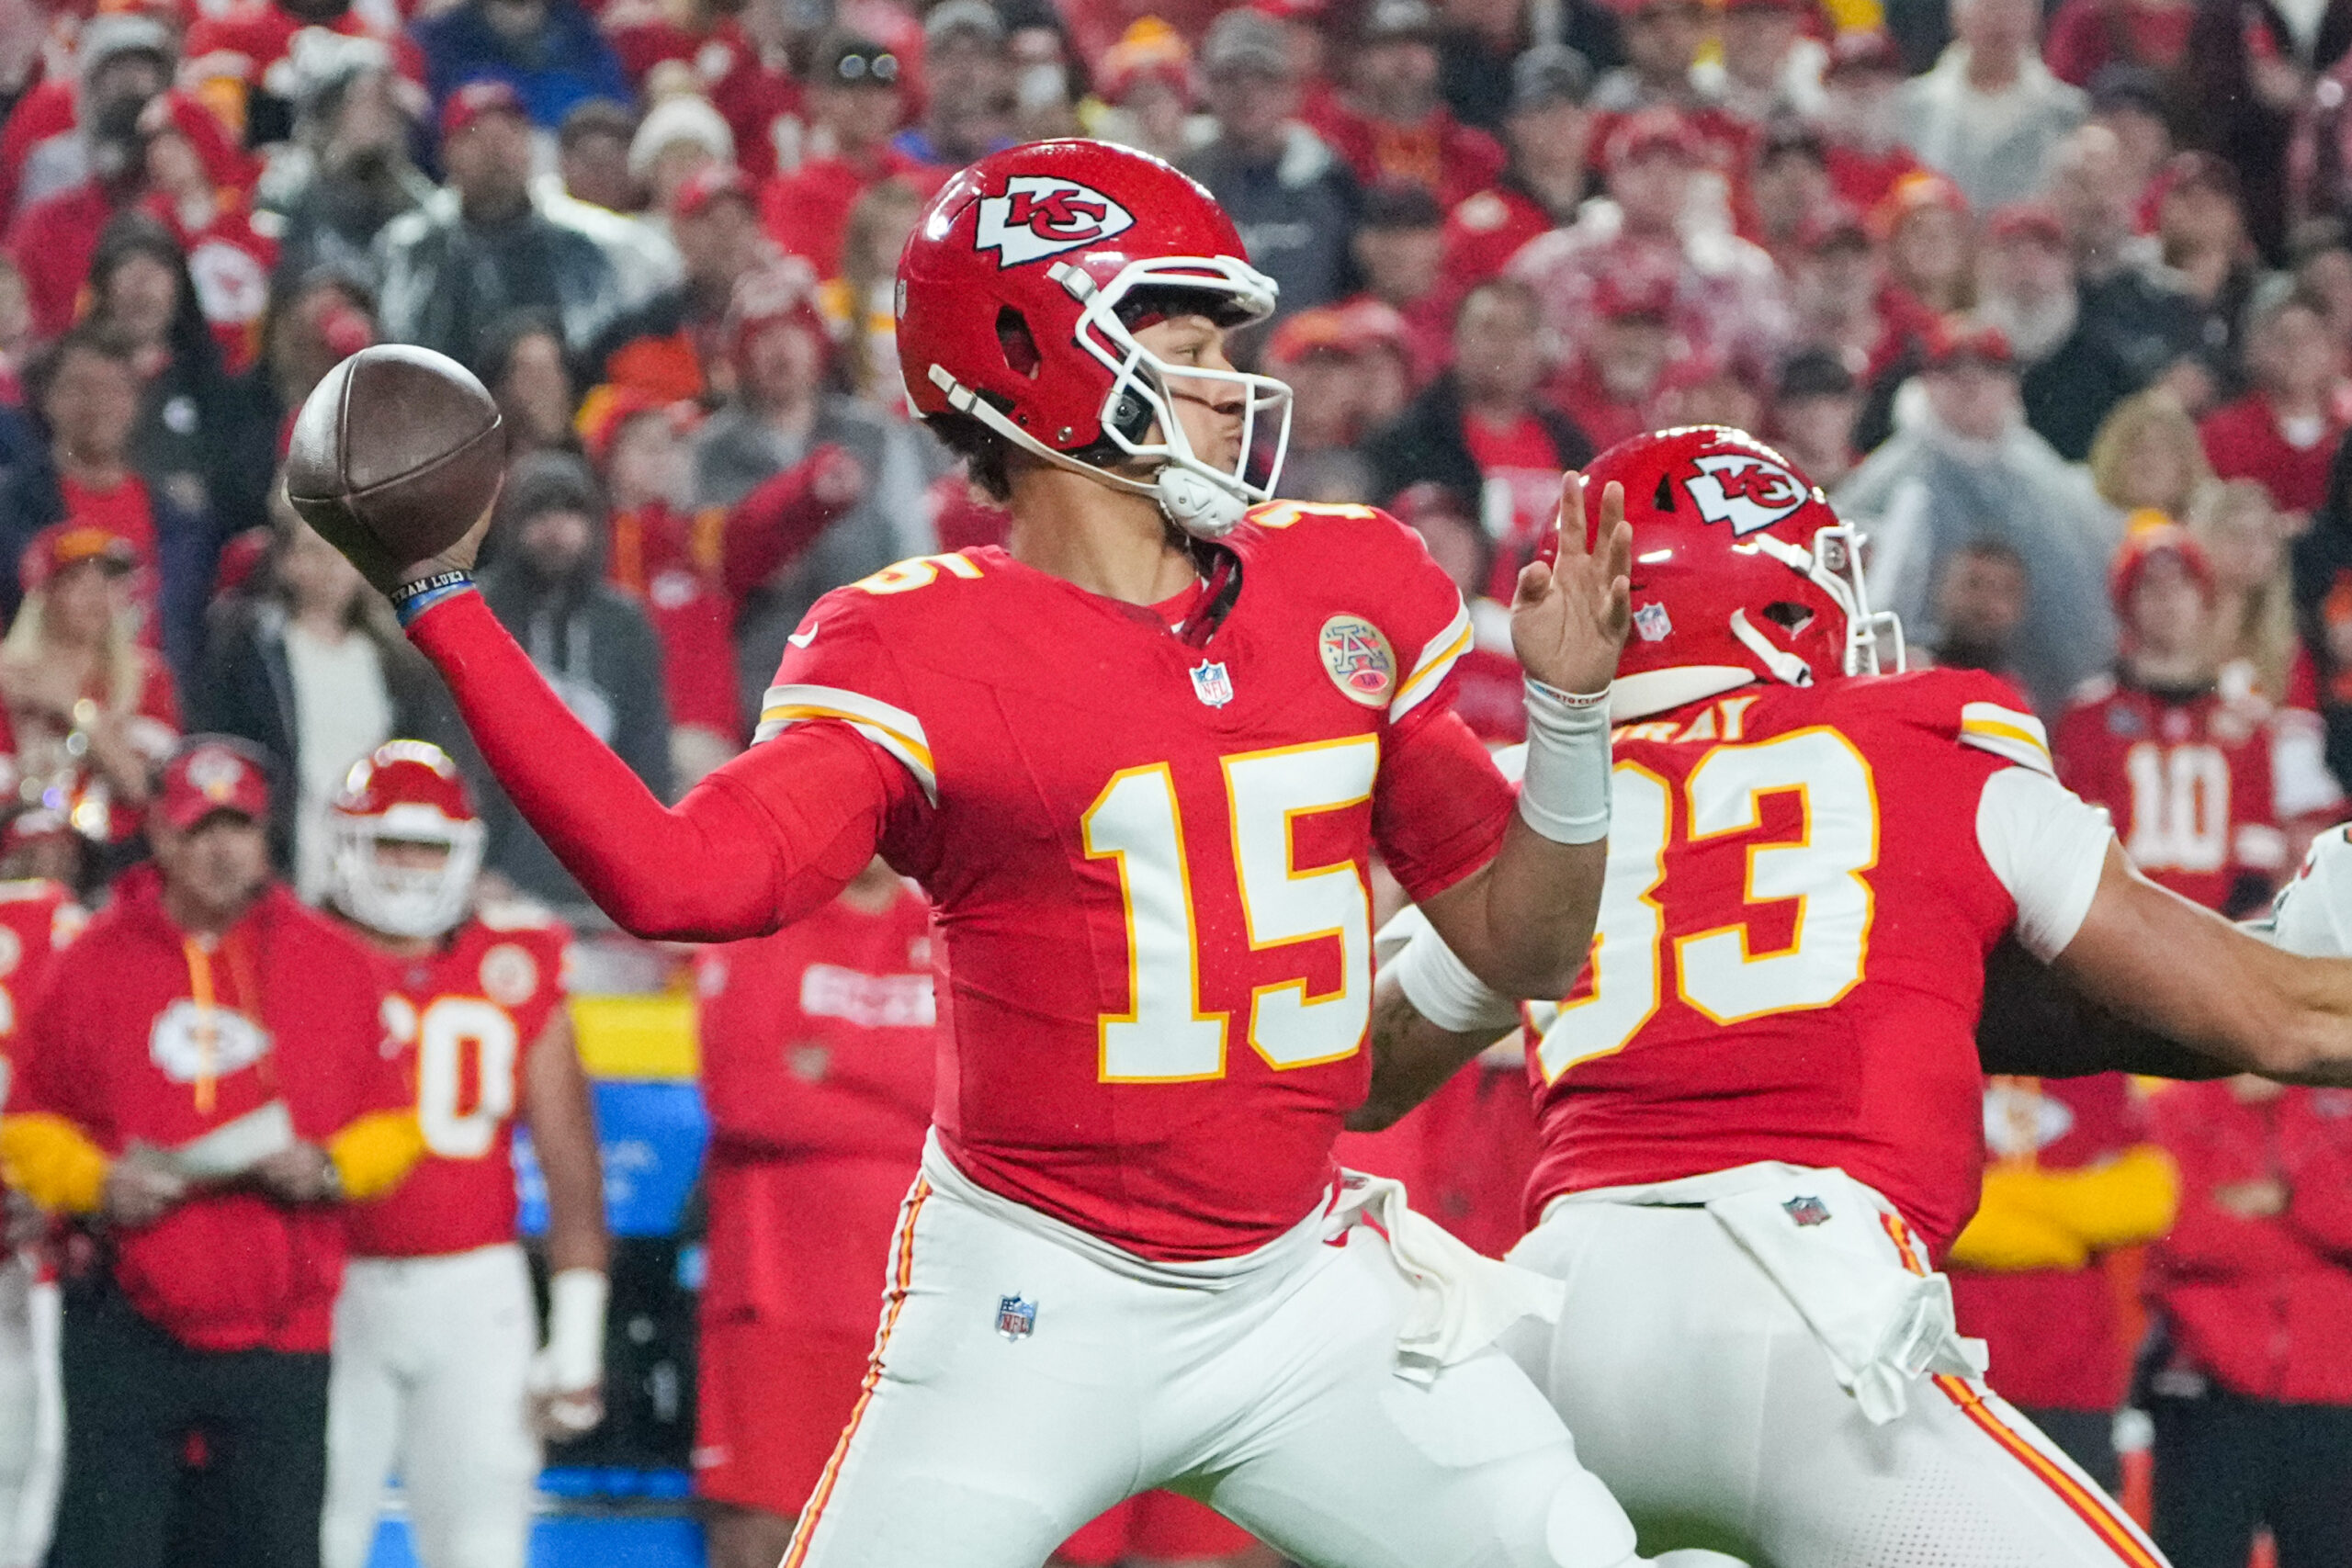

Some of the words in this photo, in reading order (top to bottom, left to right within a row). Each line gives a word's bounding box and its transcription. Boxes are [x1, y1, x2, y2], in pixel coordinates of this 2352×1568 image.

[1004, 189, 1106, 242] KC
[1710, 464, 1798, 509] KC
[391, 580, 429, 604] TEAM
[1332, 624, 1390, 674] A
[1201, 680, 1227, 699] NFL
[1611, 694, 1760, 745] RAY
[2125, 742, 2233, 873] 10
[1080, 732, 1380, 1084] 15
